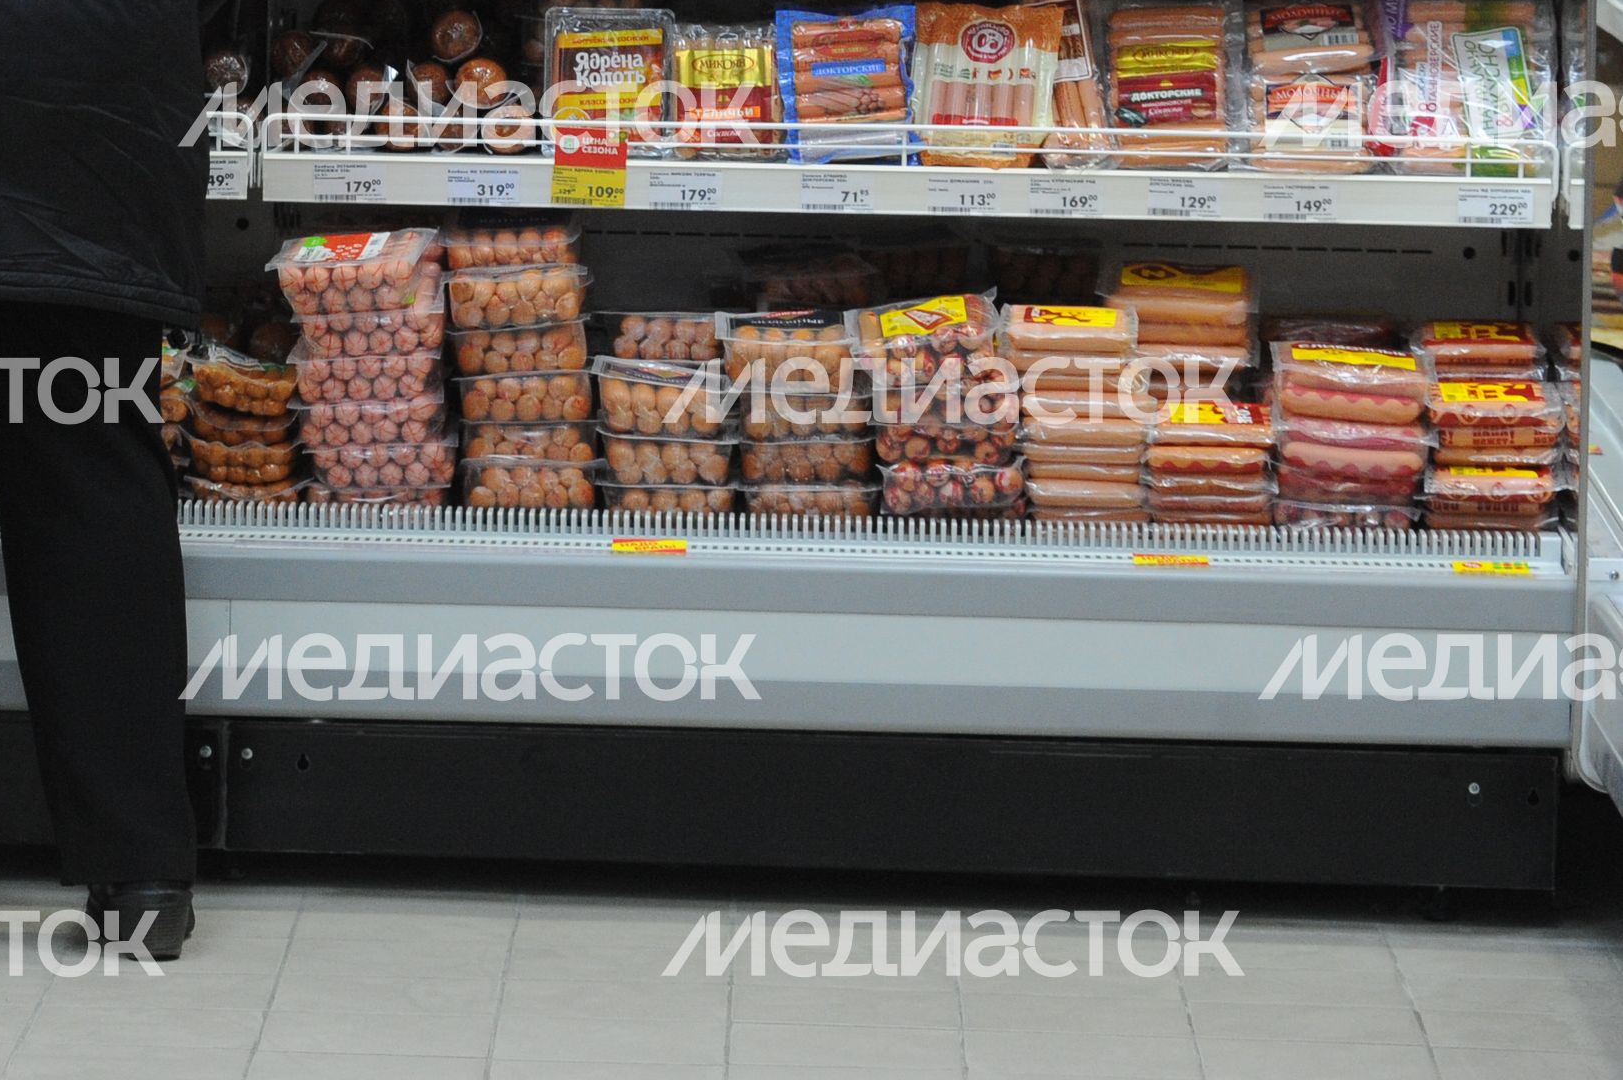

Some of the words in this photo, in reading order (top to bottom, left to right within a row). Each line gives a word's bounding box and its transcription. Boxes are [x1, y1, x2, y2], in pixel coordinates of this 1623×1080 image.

[573, 51, 644, 72] Ядрёна
[813, 62, 883, 76] ДОКТОРСКИЕ
[573, 67, 646, 88] Копоть
[1130, 88, 1202, 102] ДОКТОРСКИЕ
[582, 137, 608, 146] ЦЕНА
[582, 146, 618, 155] СЕЗОНА
